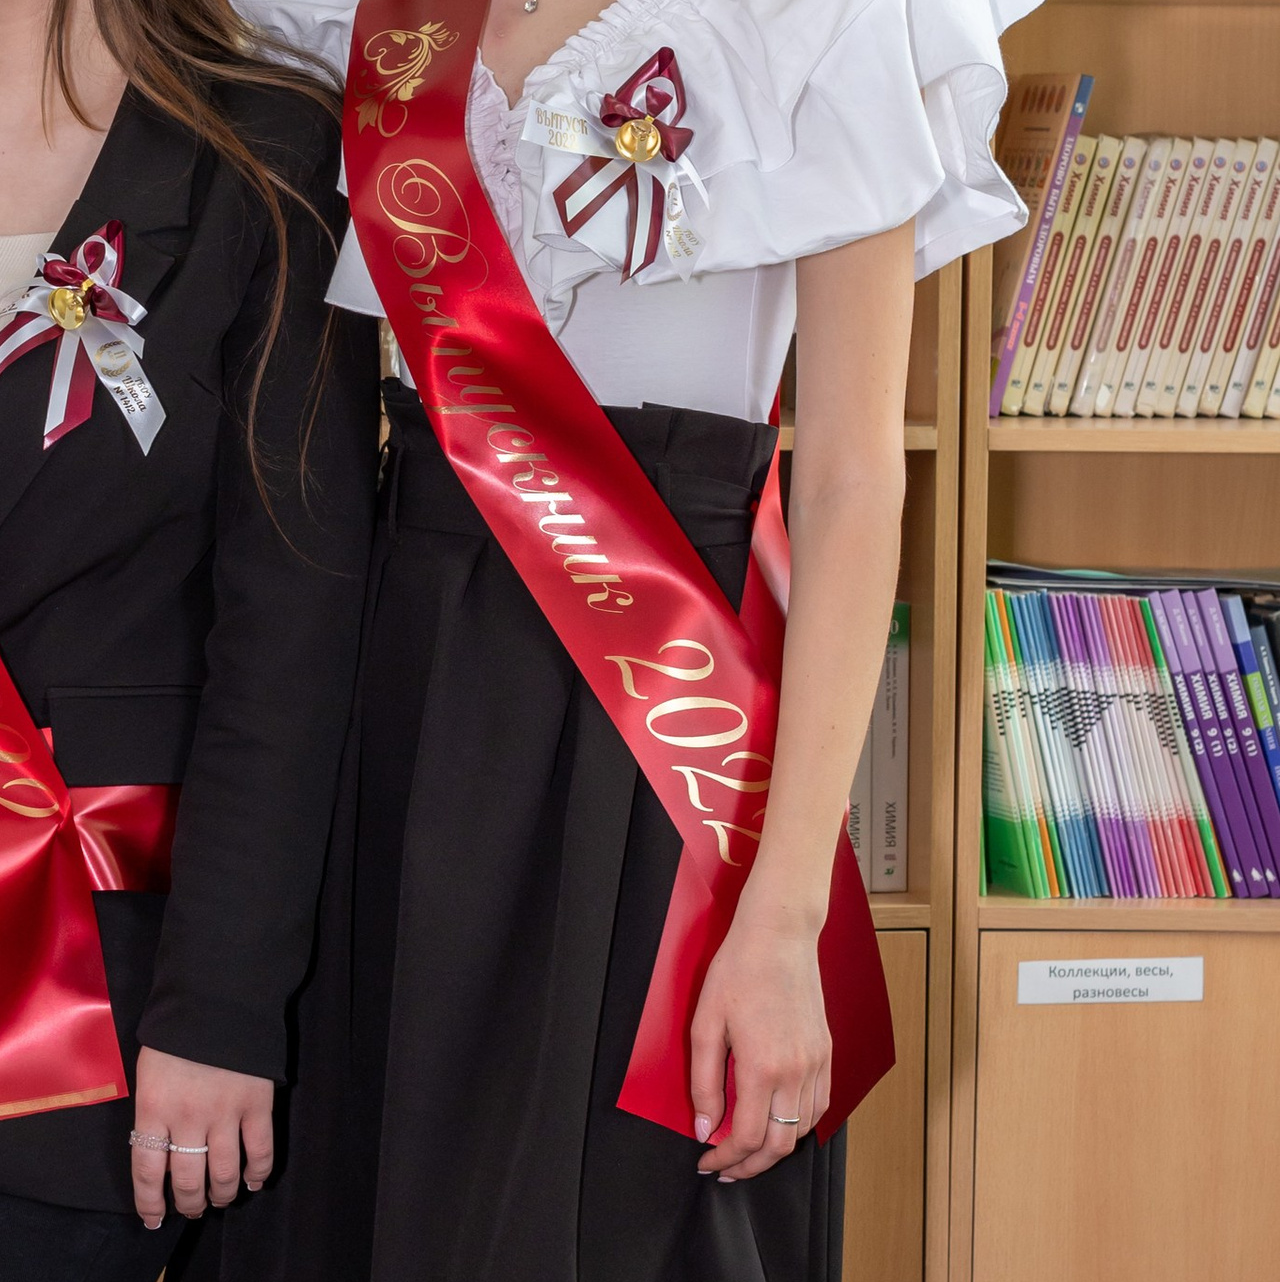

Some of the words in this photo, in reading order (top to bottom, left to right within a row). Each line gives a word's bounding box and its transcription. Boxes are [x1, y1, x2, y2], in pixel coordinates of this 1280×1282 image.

[1055, 136, 1075, 186] ЗДОРОВО
[1045, 188, 1061, 219] БЫТЬ
[1062, 171, 1083, 214] Химия
[1085, 174, 1106, 217] Химия
[1110, 174, 1131, 217] Химия
[1156, 176, 1178, 219] Химия
[1179, 174, 1201, 217] Химия
[1200, 173, 1222, 217] Химия
[1220, 178, 1242, 221] Химия
[1242, 178, 1263, 221] Химия
[1026, 223, 1050, 285] ЗДОРОВЫМ
[120, 397, 136, 415] 1412
[122, 375, 147, 413] Школа
[376, 158, 635, 617] Выпускник
[1174, 674, 1195, 721] ХИМИЯ
[1191, 673, 1213, 720] ХИМИЯ
[1208, 673, 1228, 720] ХИМИЯ
[1226, 672, 1248, 719] ХИМИЯ
[1191, 729, 1200, 738] 9
[1194, 738, 1205, 755] (2)
[1207, 727, 1218, 737] 9
[1210, 739, 1224, 757] (1)
[1224, 728, 1233, 737] 9
[1226, 738, 1238, 755] (2)
[1242, 727, 1253, 737] 9
[1245, 739, 1258, 757] (1)
[885, 801, 897, 848] ХИМИЯ
[1048, 965, 1131, 979] Коллекции,
[1135, 965, 1174, 978] весы,
[1073, 986, 1150, 1002] разновесы
